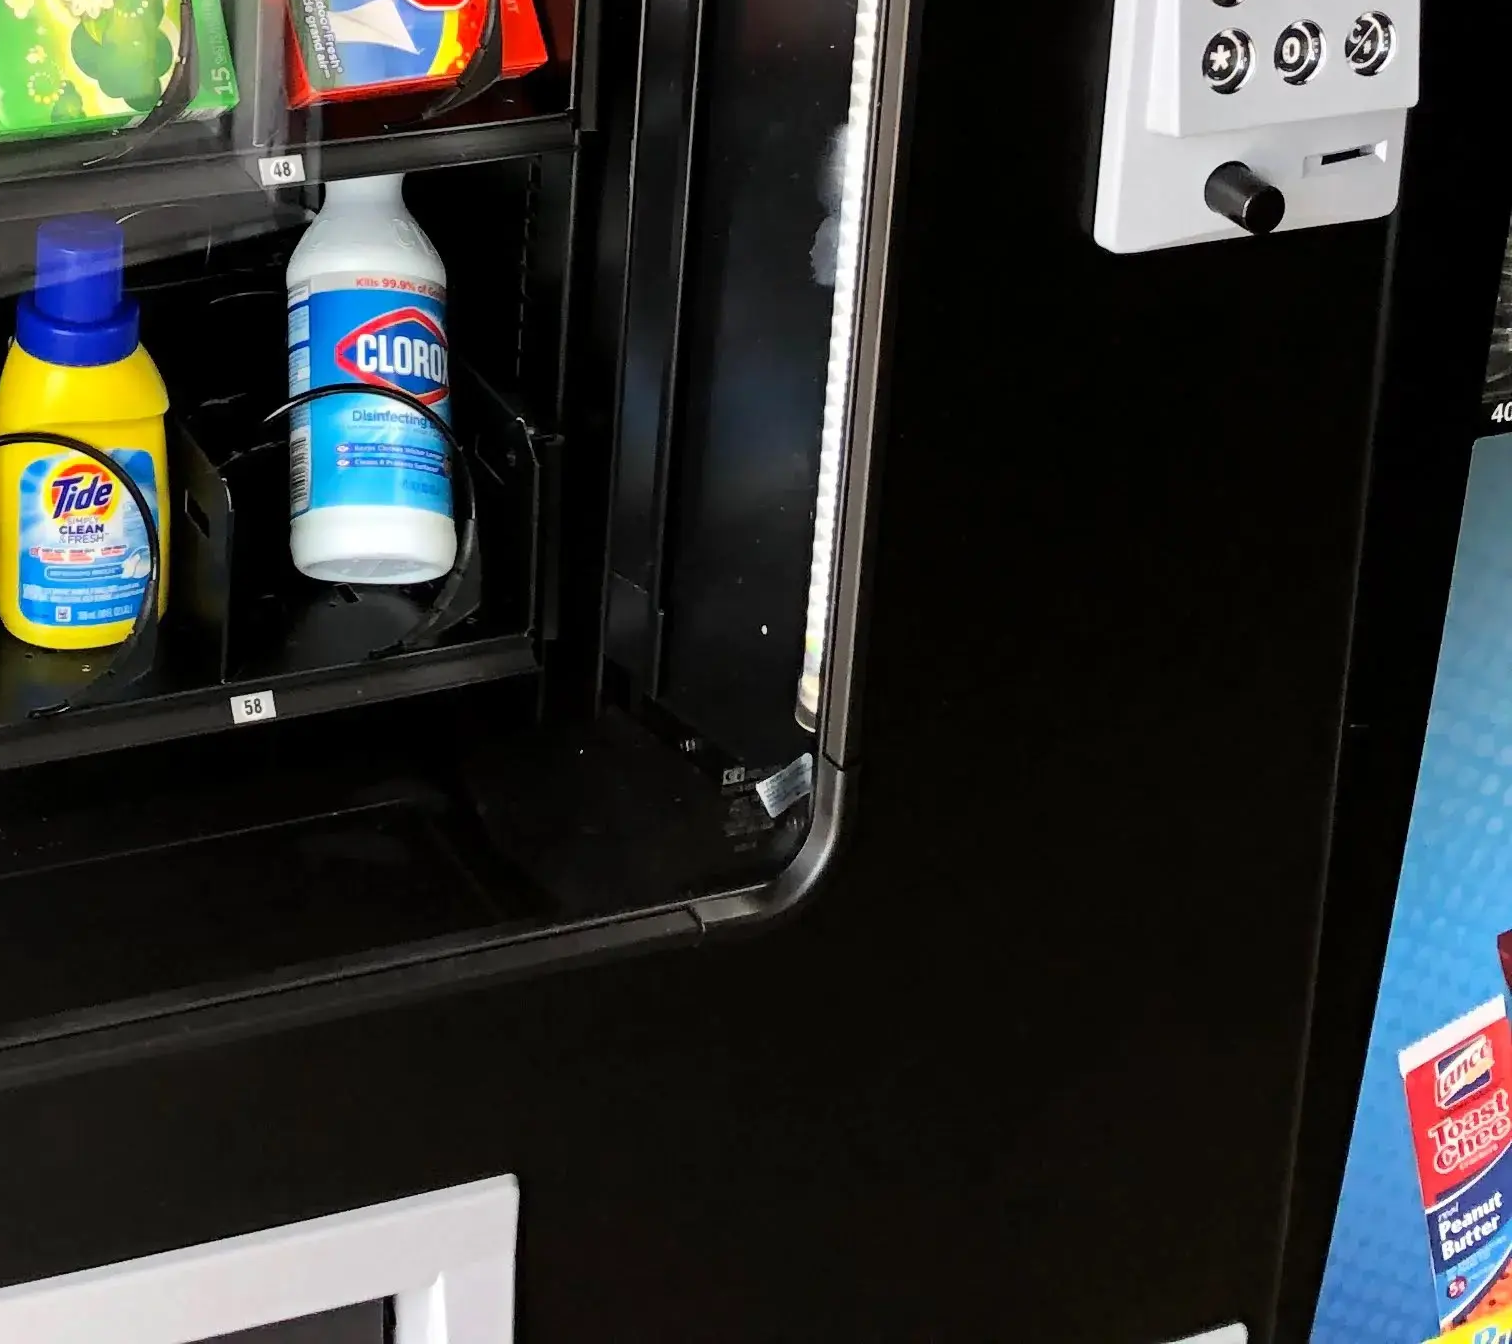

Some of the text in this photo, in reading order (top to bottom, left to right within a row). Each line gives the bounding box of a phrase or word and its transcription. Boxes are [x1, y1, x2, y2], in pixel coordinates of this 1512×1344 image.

[305, 16, 325, 52] grand
[1283, 37, 1300, 64] 0
[210, 66, 235, 96] 15
[273, 162, 291, 178] 48
[356, 277, 428, 294] Kills 99.9% of
[352, 410, 427, 429] Disinfecting
[52, 476, 113, 519] Tide
[59, 524, 104, 534] CLEAN
[59, 533, 104, 543] & FRESH
[244, 699, 263, 714] 58
[1430, 1089, 1508, 1150] Toast
[1434, 1118, 1510, 1172] Chee
[1439, 1191, 1502, 1241] Peanut
[1441, 1213, 1500, 1261] Butter
